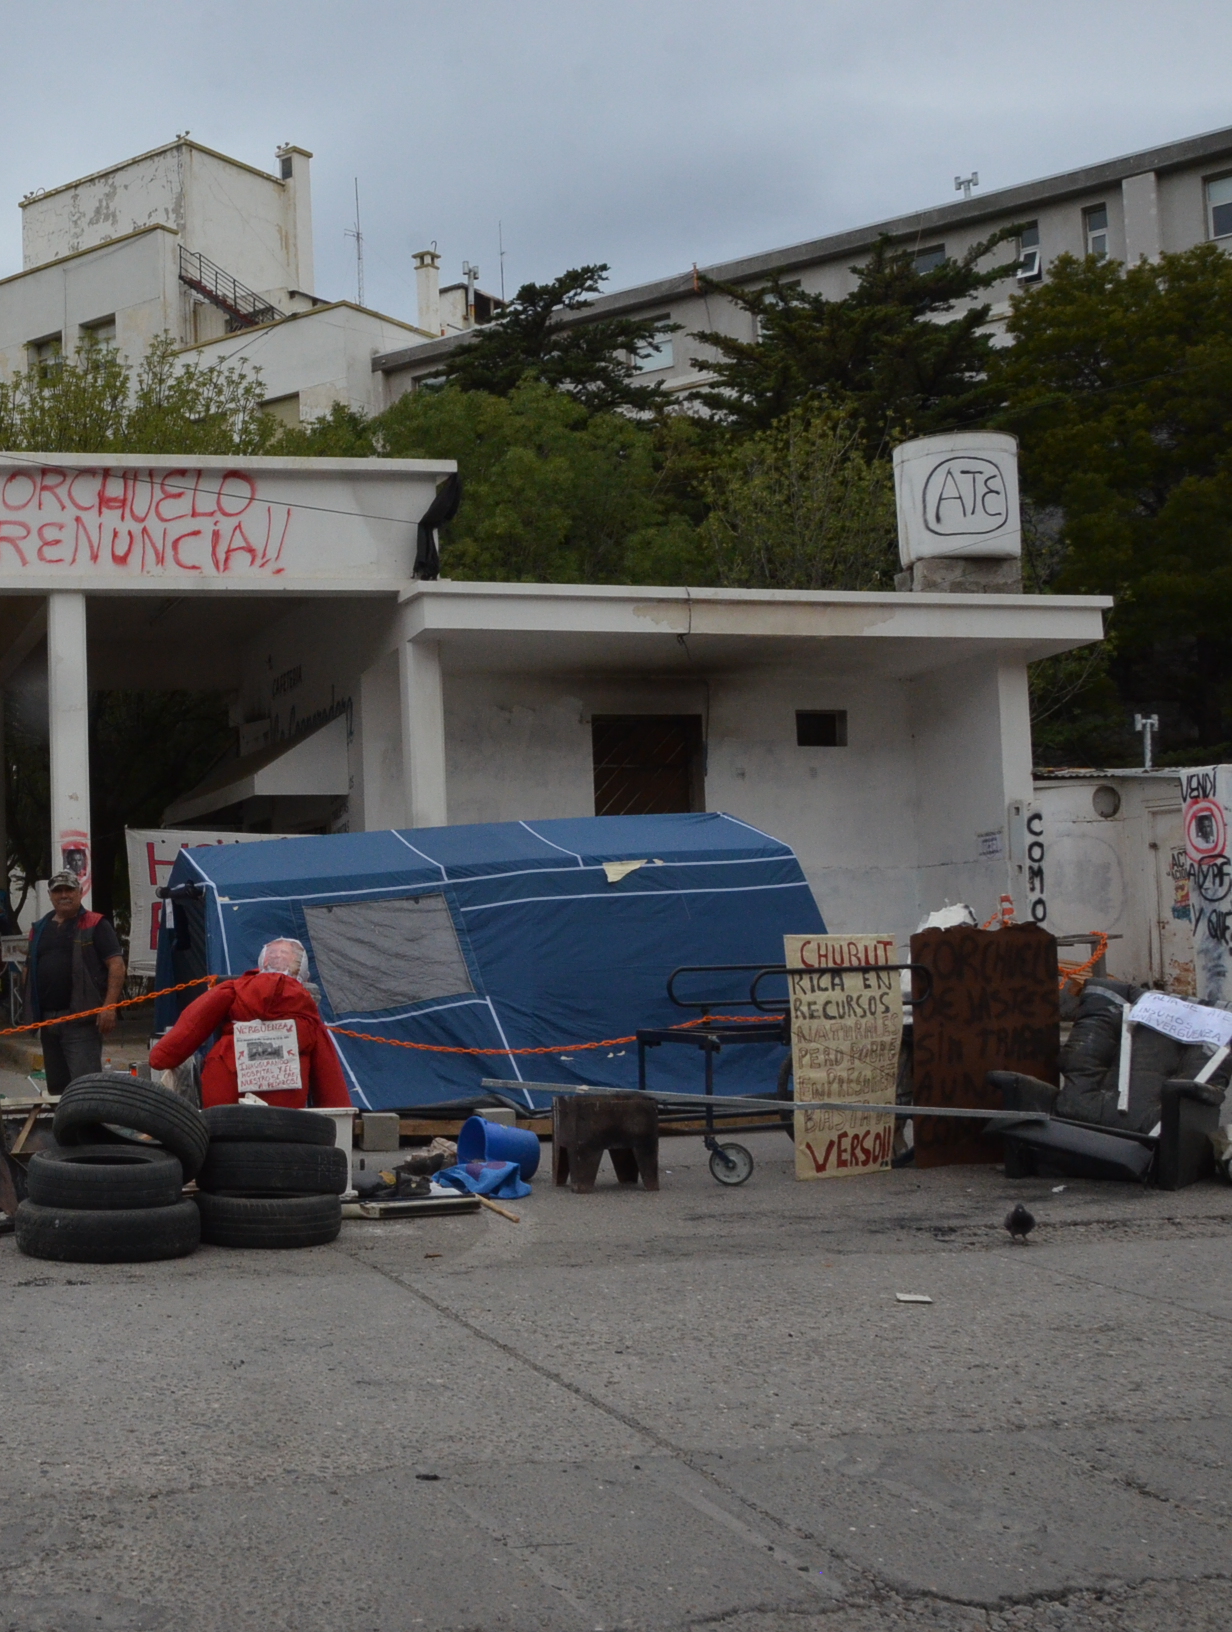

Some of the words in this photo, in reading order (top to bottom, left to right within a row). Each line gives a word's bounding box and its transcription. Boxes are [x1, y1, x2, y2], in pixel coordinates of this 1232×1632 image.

[934, 467, 1002, 525] ATE
[1026, 812, 1047, 923] COMO
[800, 940, 894, 968] CHUBUT
[791, 970, 845, 995] RICA
[862, 970, 892, 991] EN
[793, 992, 891, 1021] RECURSOS
[1138, 1007, 1193, 1030] INSUMOS
[795, 1012, 899, 1044] NATURALES
[798, 1046, 844, 1069] PERO
[241, 1067, 275, 1079] HOSPITAL
